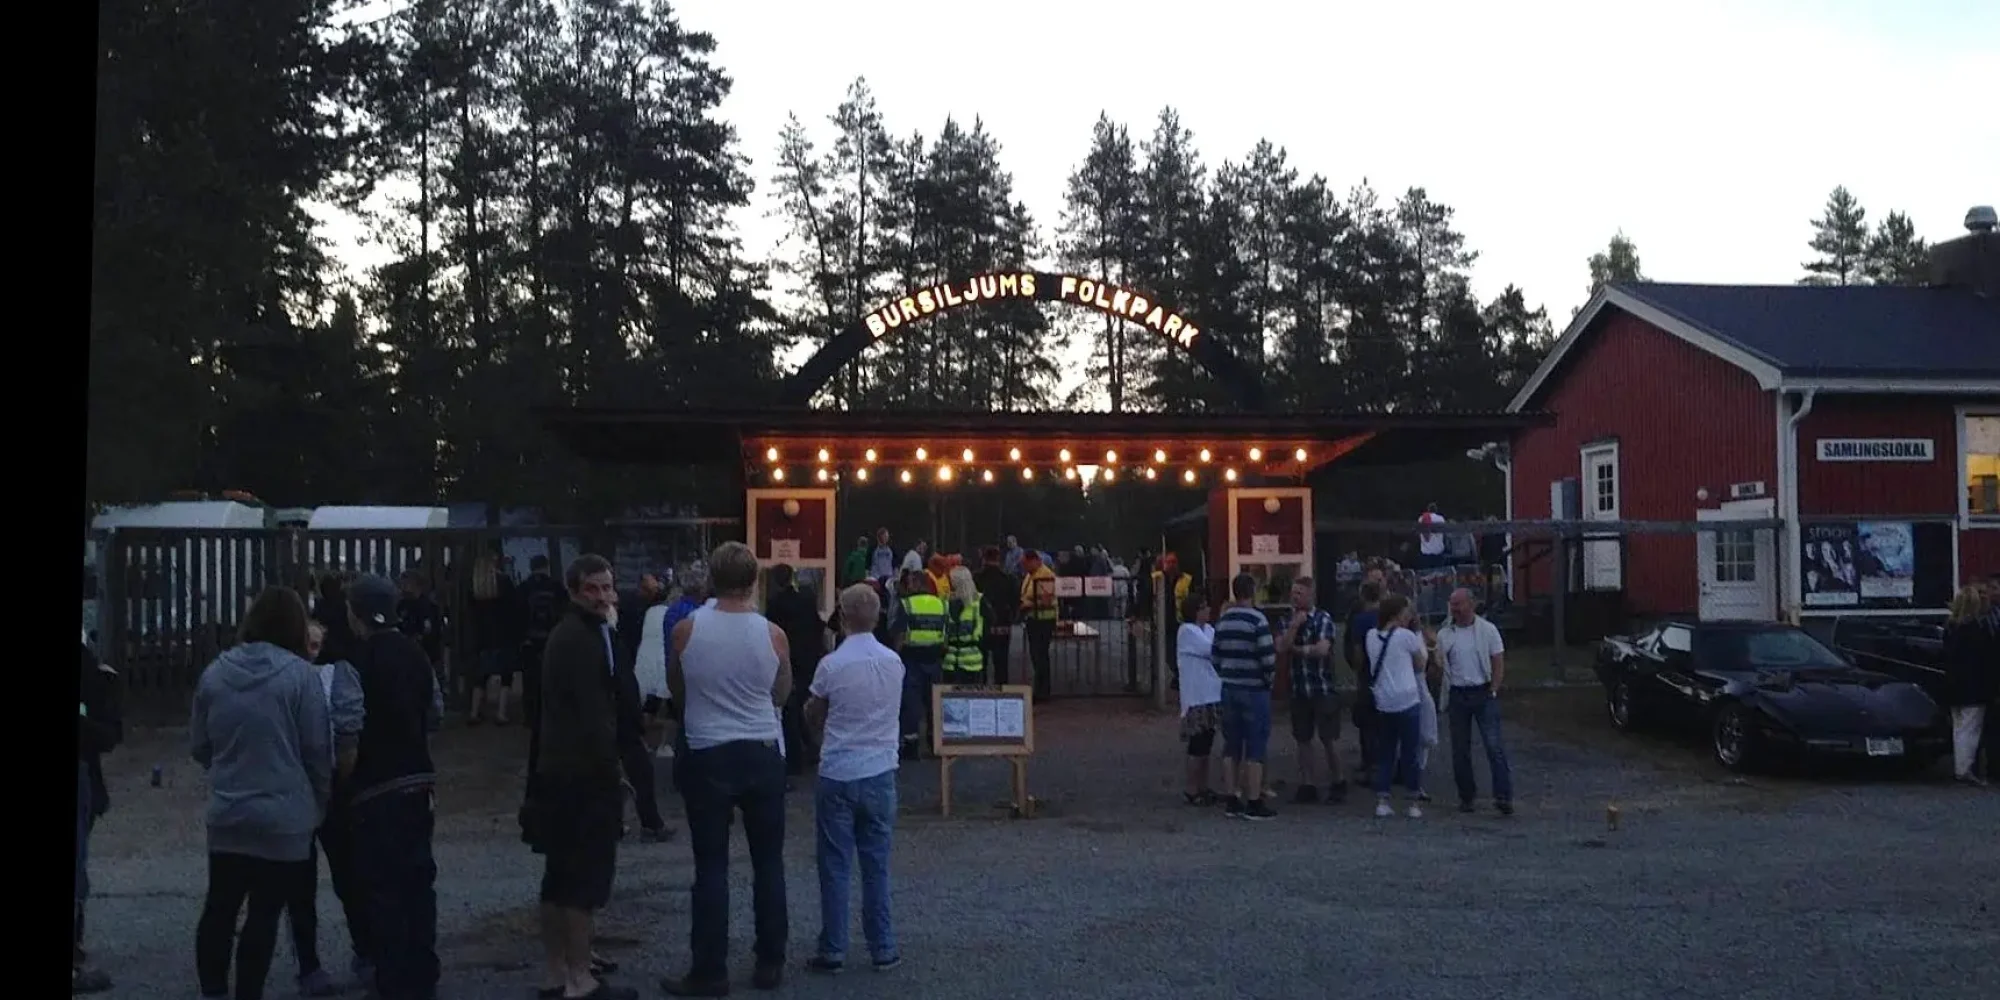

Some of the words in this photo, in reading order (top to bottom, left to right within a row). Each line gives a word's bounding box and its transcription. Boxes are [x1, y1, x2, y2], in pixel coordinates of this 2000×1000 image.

[865, 273, 1037, 338] BURSILJUMS
[1061, 276, 1200, 348] FOLKPARK
[1824, 441, 1927, 458] SAMLINGSLOKAL
